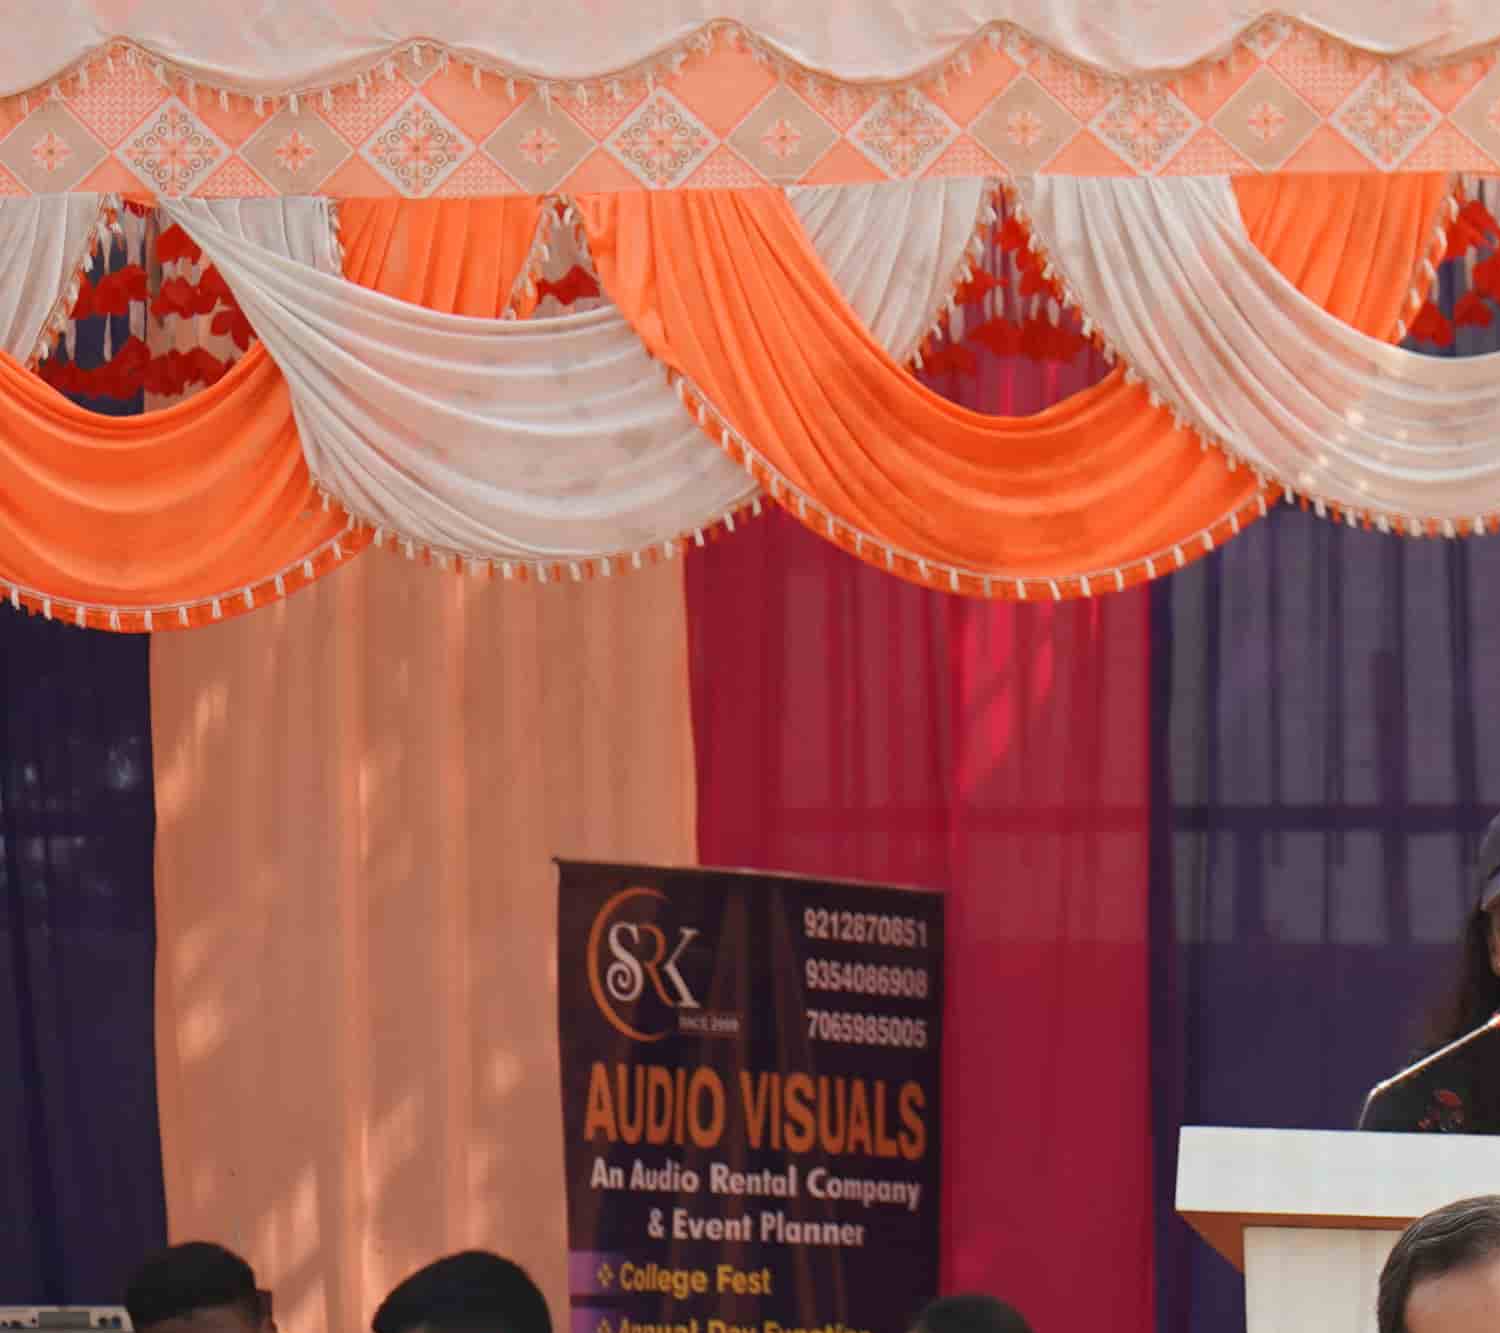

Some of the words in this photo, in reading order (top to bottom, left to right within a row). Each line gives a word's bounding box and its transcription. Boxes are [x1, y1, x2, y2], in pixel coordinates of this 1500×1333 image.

[584, 1063, 727, 1148] AUDIO
[740, 1072, 926, 1160] VISUALS
[590, 1157, 624, 1189] An
[630, 1158, 698, 1193] Audio
[710, 1163, 797, 1197] Rental
[807, 1168, 921, 1210] Company
[648, 1208, 664, 1238] &
[673, 1209, 752, 1242] Event
[761, 1212, 865, 1246] Planner
[620, 1262, 707, 1299] College
[717, 1265, 772, 1295] Fest
